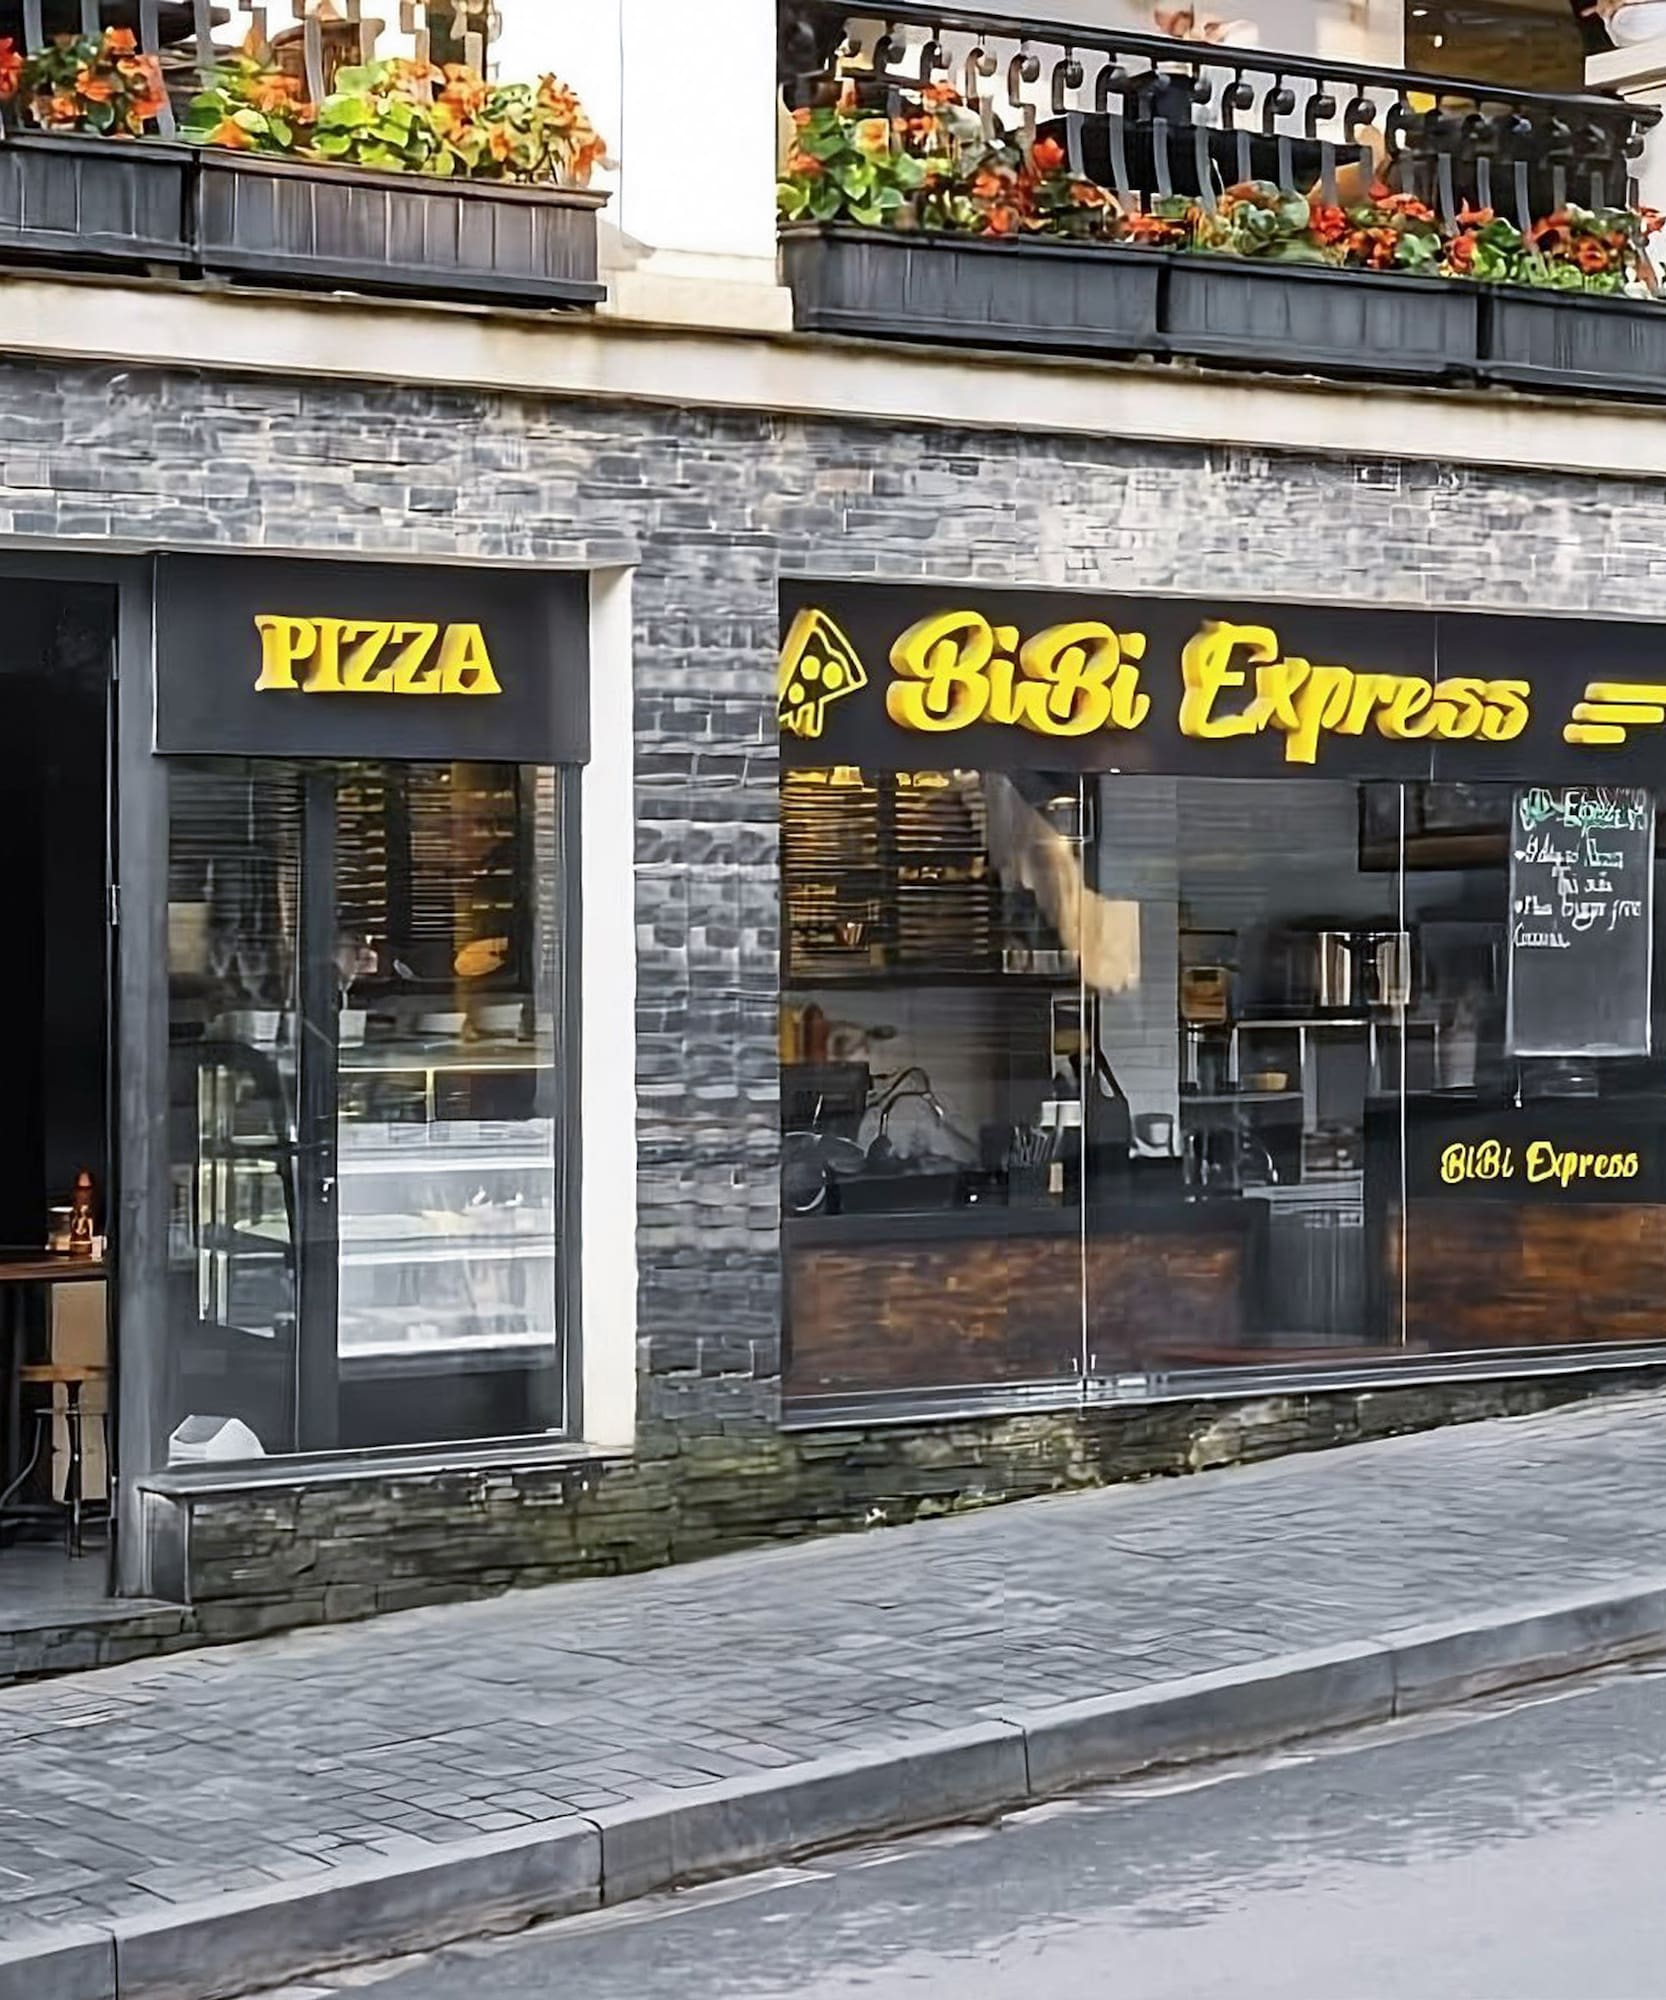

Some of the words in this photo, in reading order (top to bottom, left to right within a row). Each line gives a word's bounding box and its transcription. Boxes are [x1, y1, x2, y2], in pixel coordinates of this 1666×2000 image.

[254, 615, 503, 695] PIZZA
[886, 610, 1151, 737] BiBi
[1180, 620, 1530, 763] Express
[1526, 1141, 1639, 1188] Express
